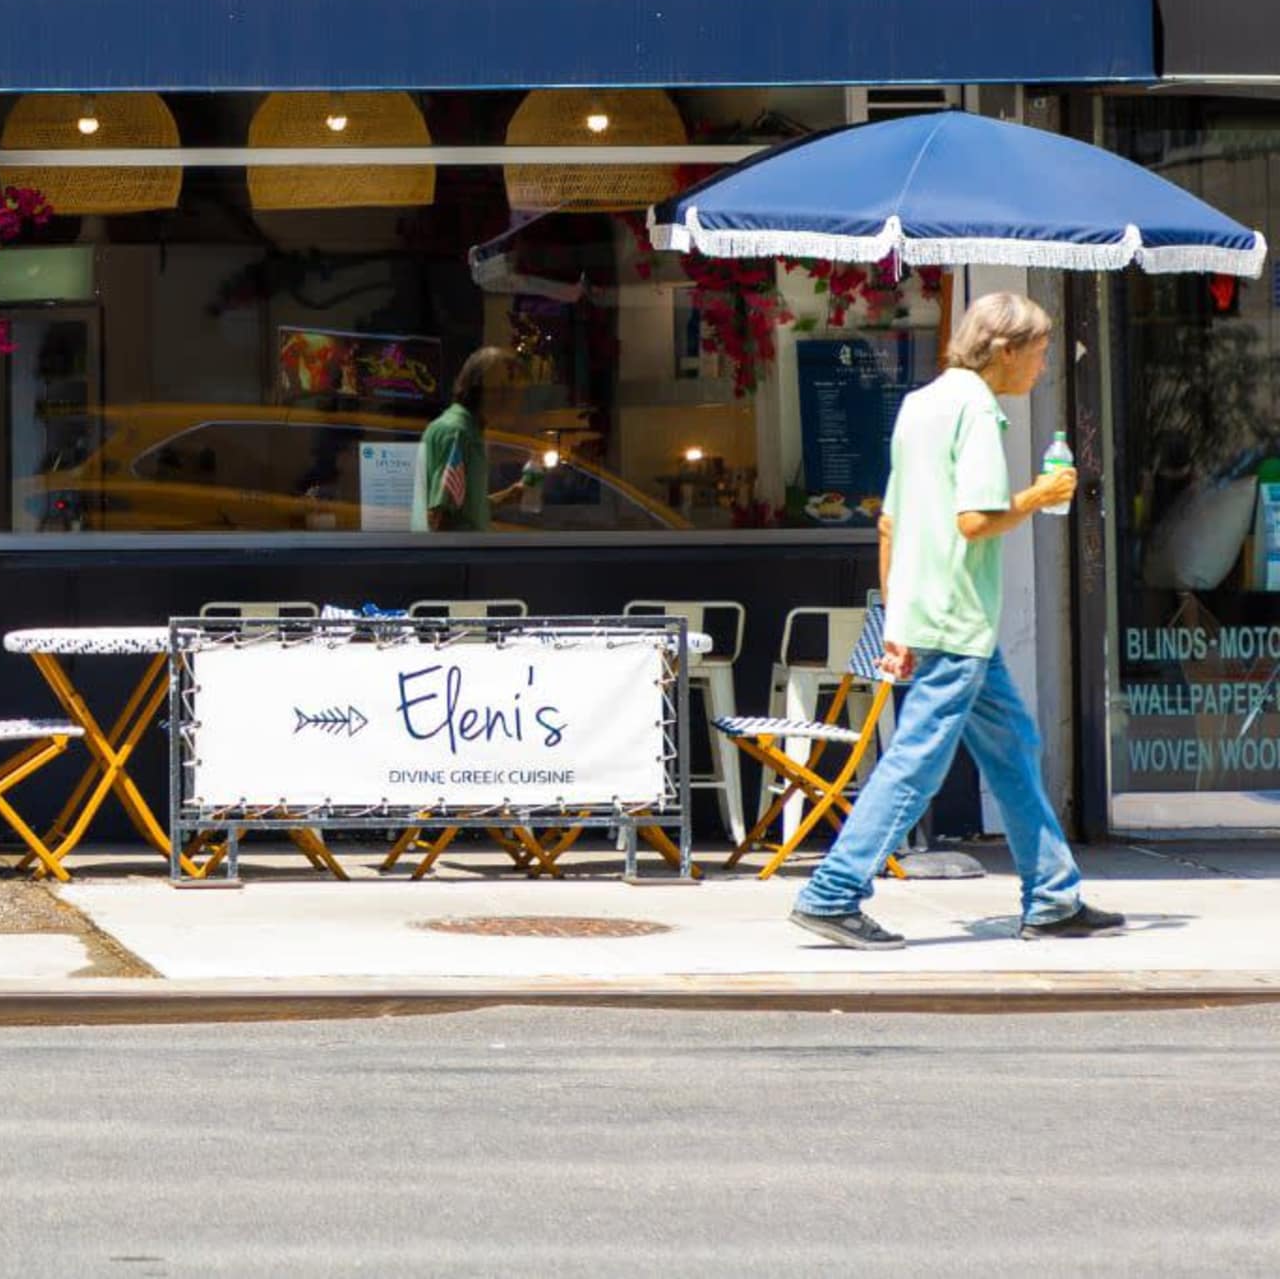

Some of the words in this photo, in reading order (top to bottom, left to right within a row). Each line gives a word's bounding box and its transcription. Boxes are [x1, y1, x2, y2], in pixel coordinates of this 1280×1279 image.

[396, 664, 568, 754] Eleni's
[1129, 739, 1213, 771] WOVEN
[1220, 737, 1280, 770] WOO
[389, 770, 445, 784] DIVINE
[450, 770, 505, 784] GREEK
[509, 770, 575, 784] CUISINE
